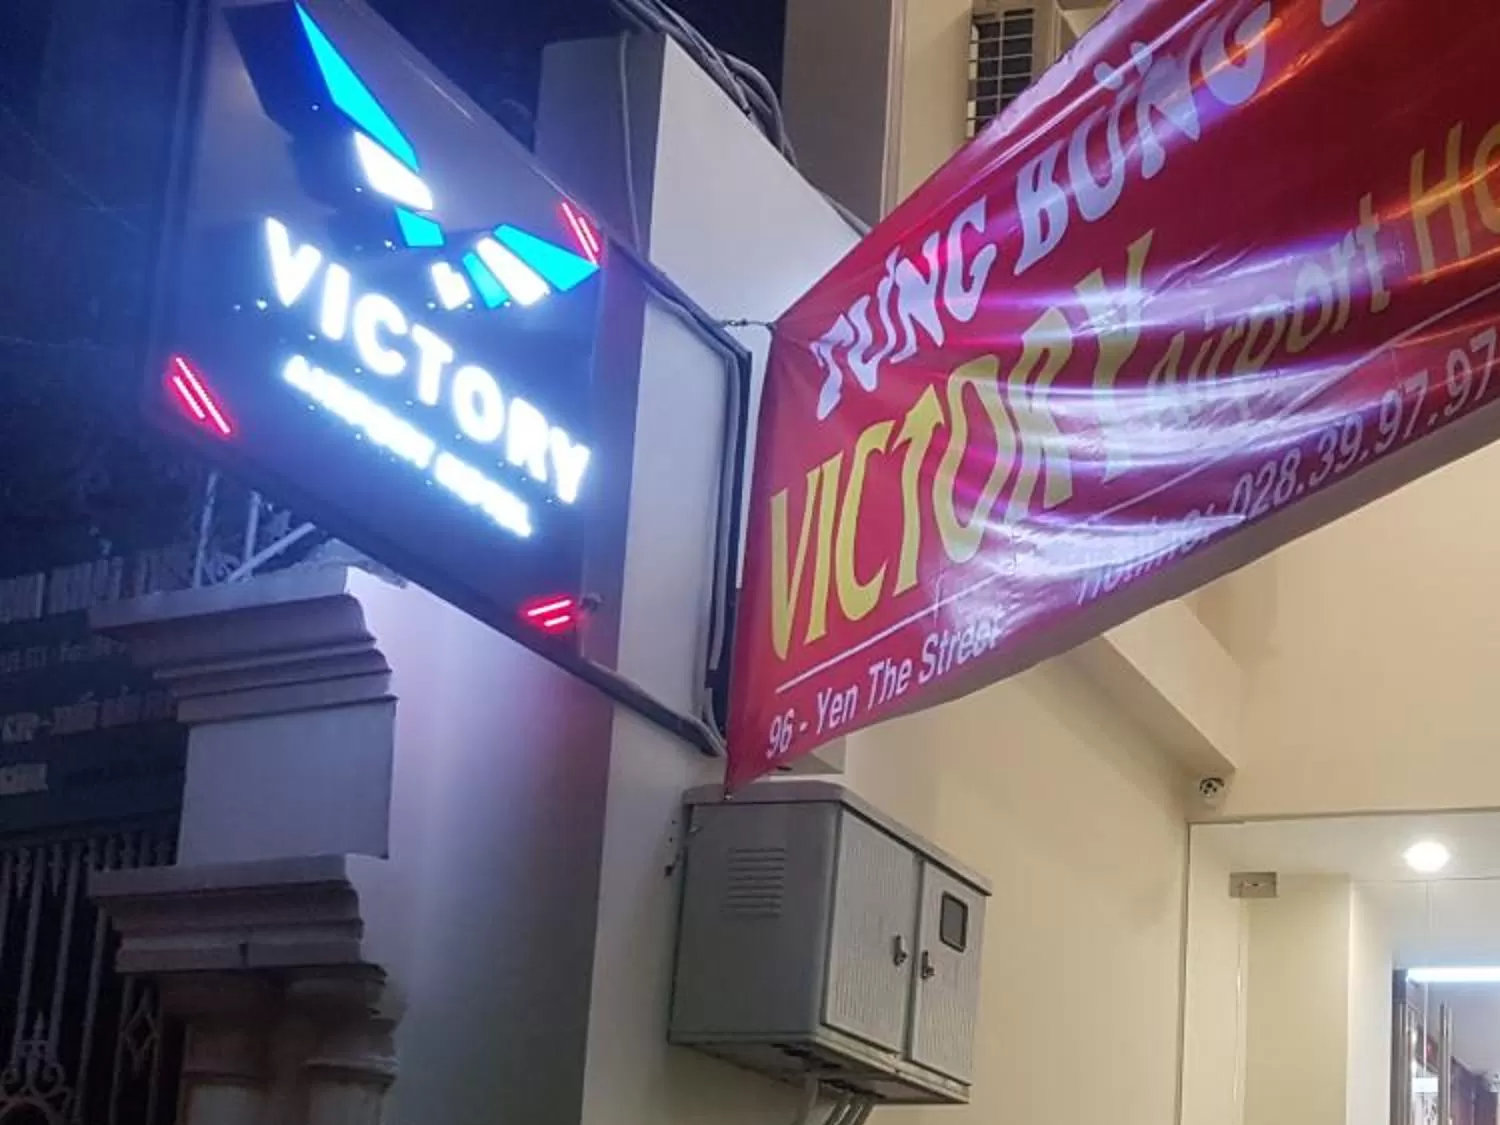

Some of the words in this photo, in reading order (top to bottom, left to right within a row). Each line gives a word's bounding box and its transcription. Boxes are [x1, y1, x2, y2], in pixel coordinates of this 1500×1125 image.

[264, 216, 591, 504] VICTORY
[766, 707, 796, 760] 96
[815, 686, 858, 735] Yen
[867, 654, 913, 711] The
